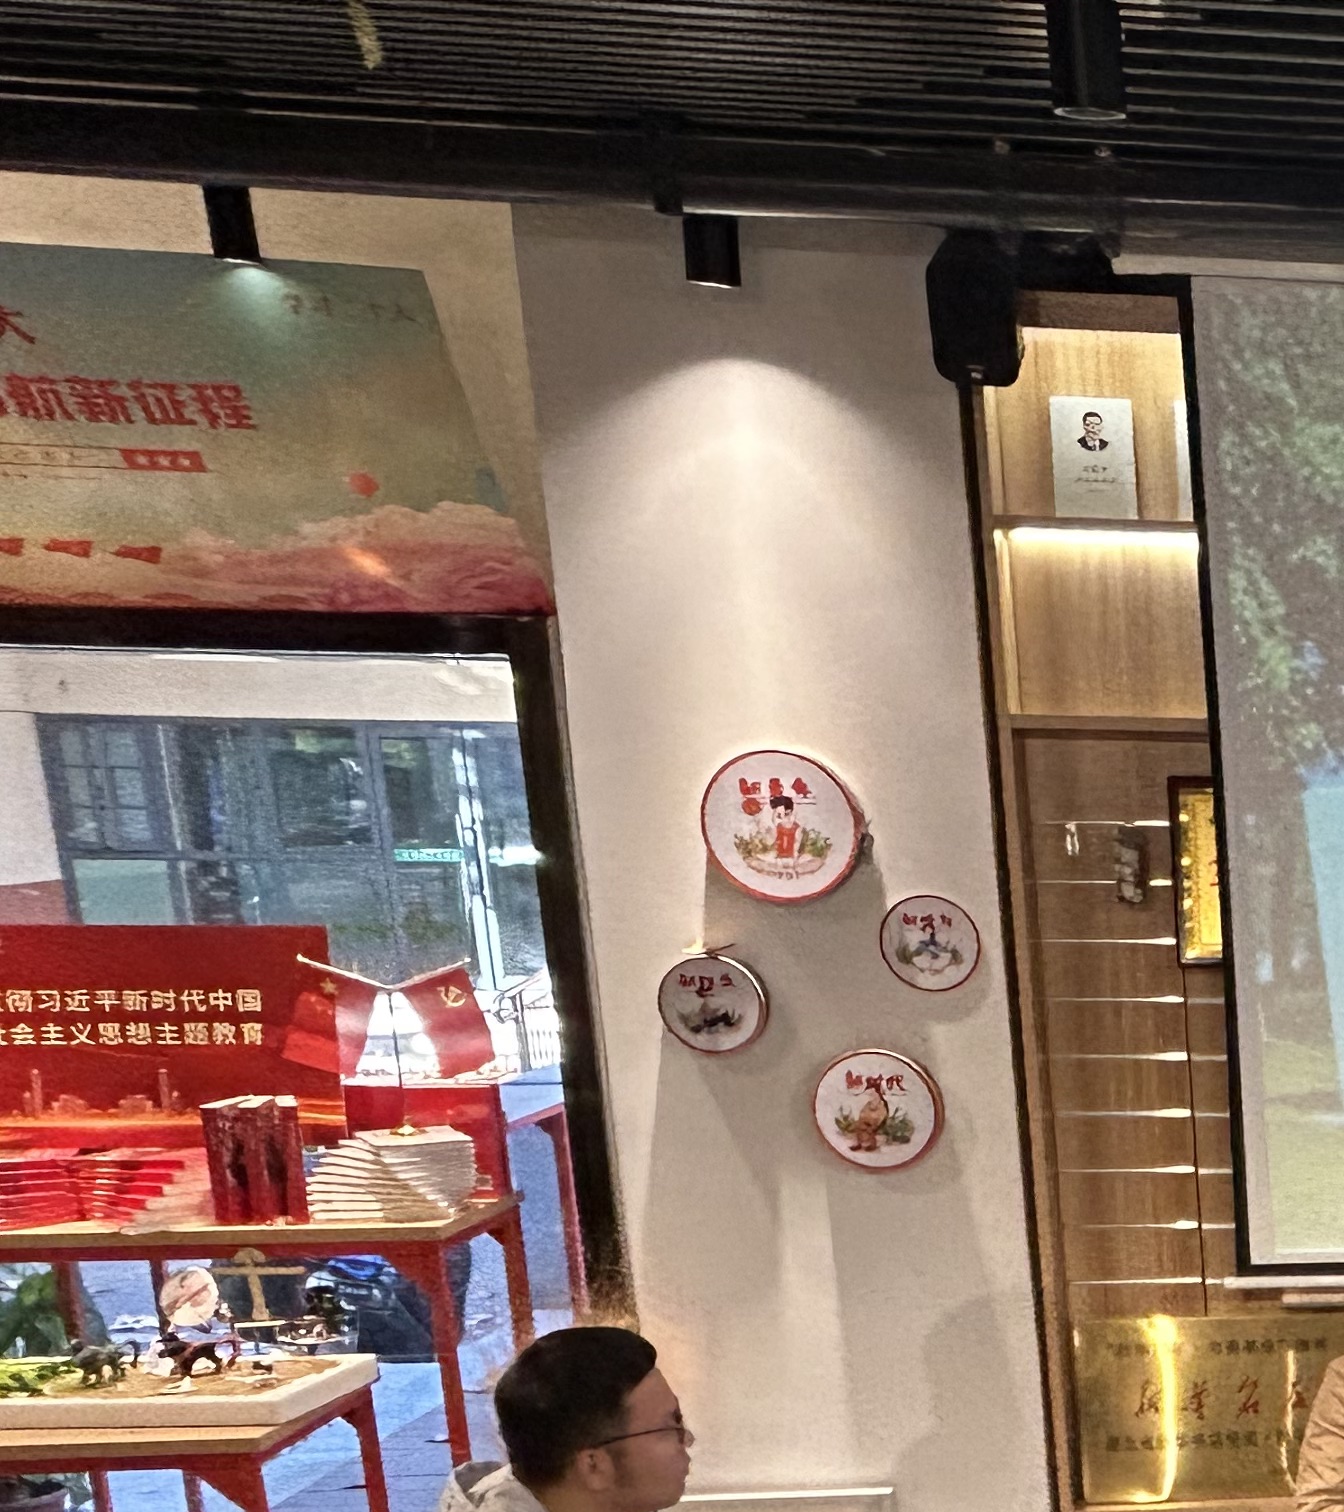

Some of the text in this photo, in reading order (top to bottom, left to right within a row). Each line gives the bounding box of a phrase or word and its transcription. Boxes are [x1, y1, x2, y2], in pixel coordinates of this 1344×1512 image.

[0, 372, 259, 431] 航新征程
[0, 988, 263, 1013] 彻习近平新时代中国
